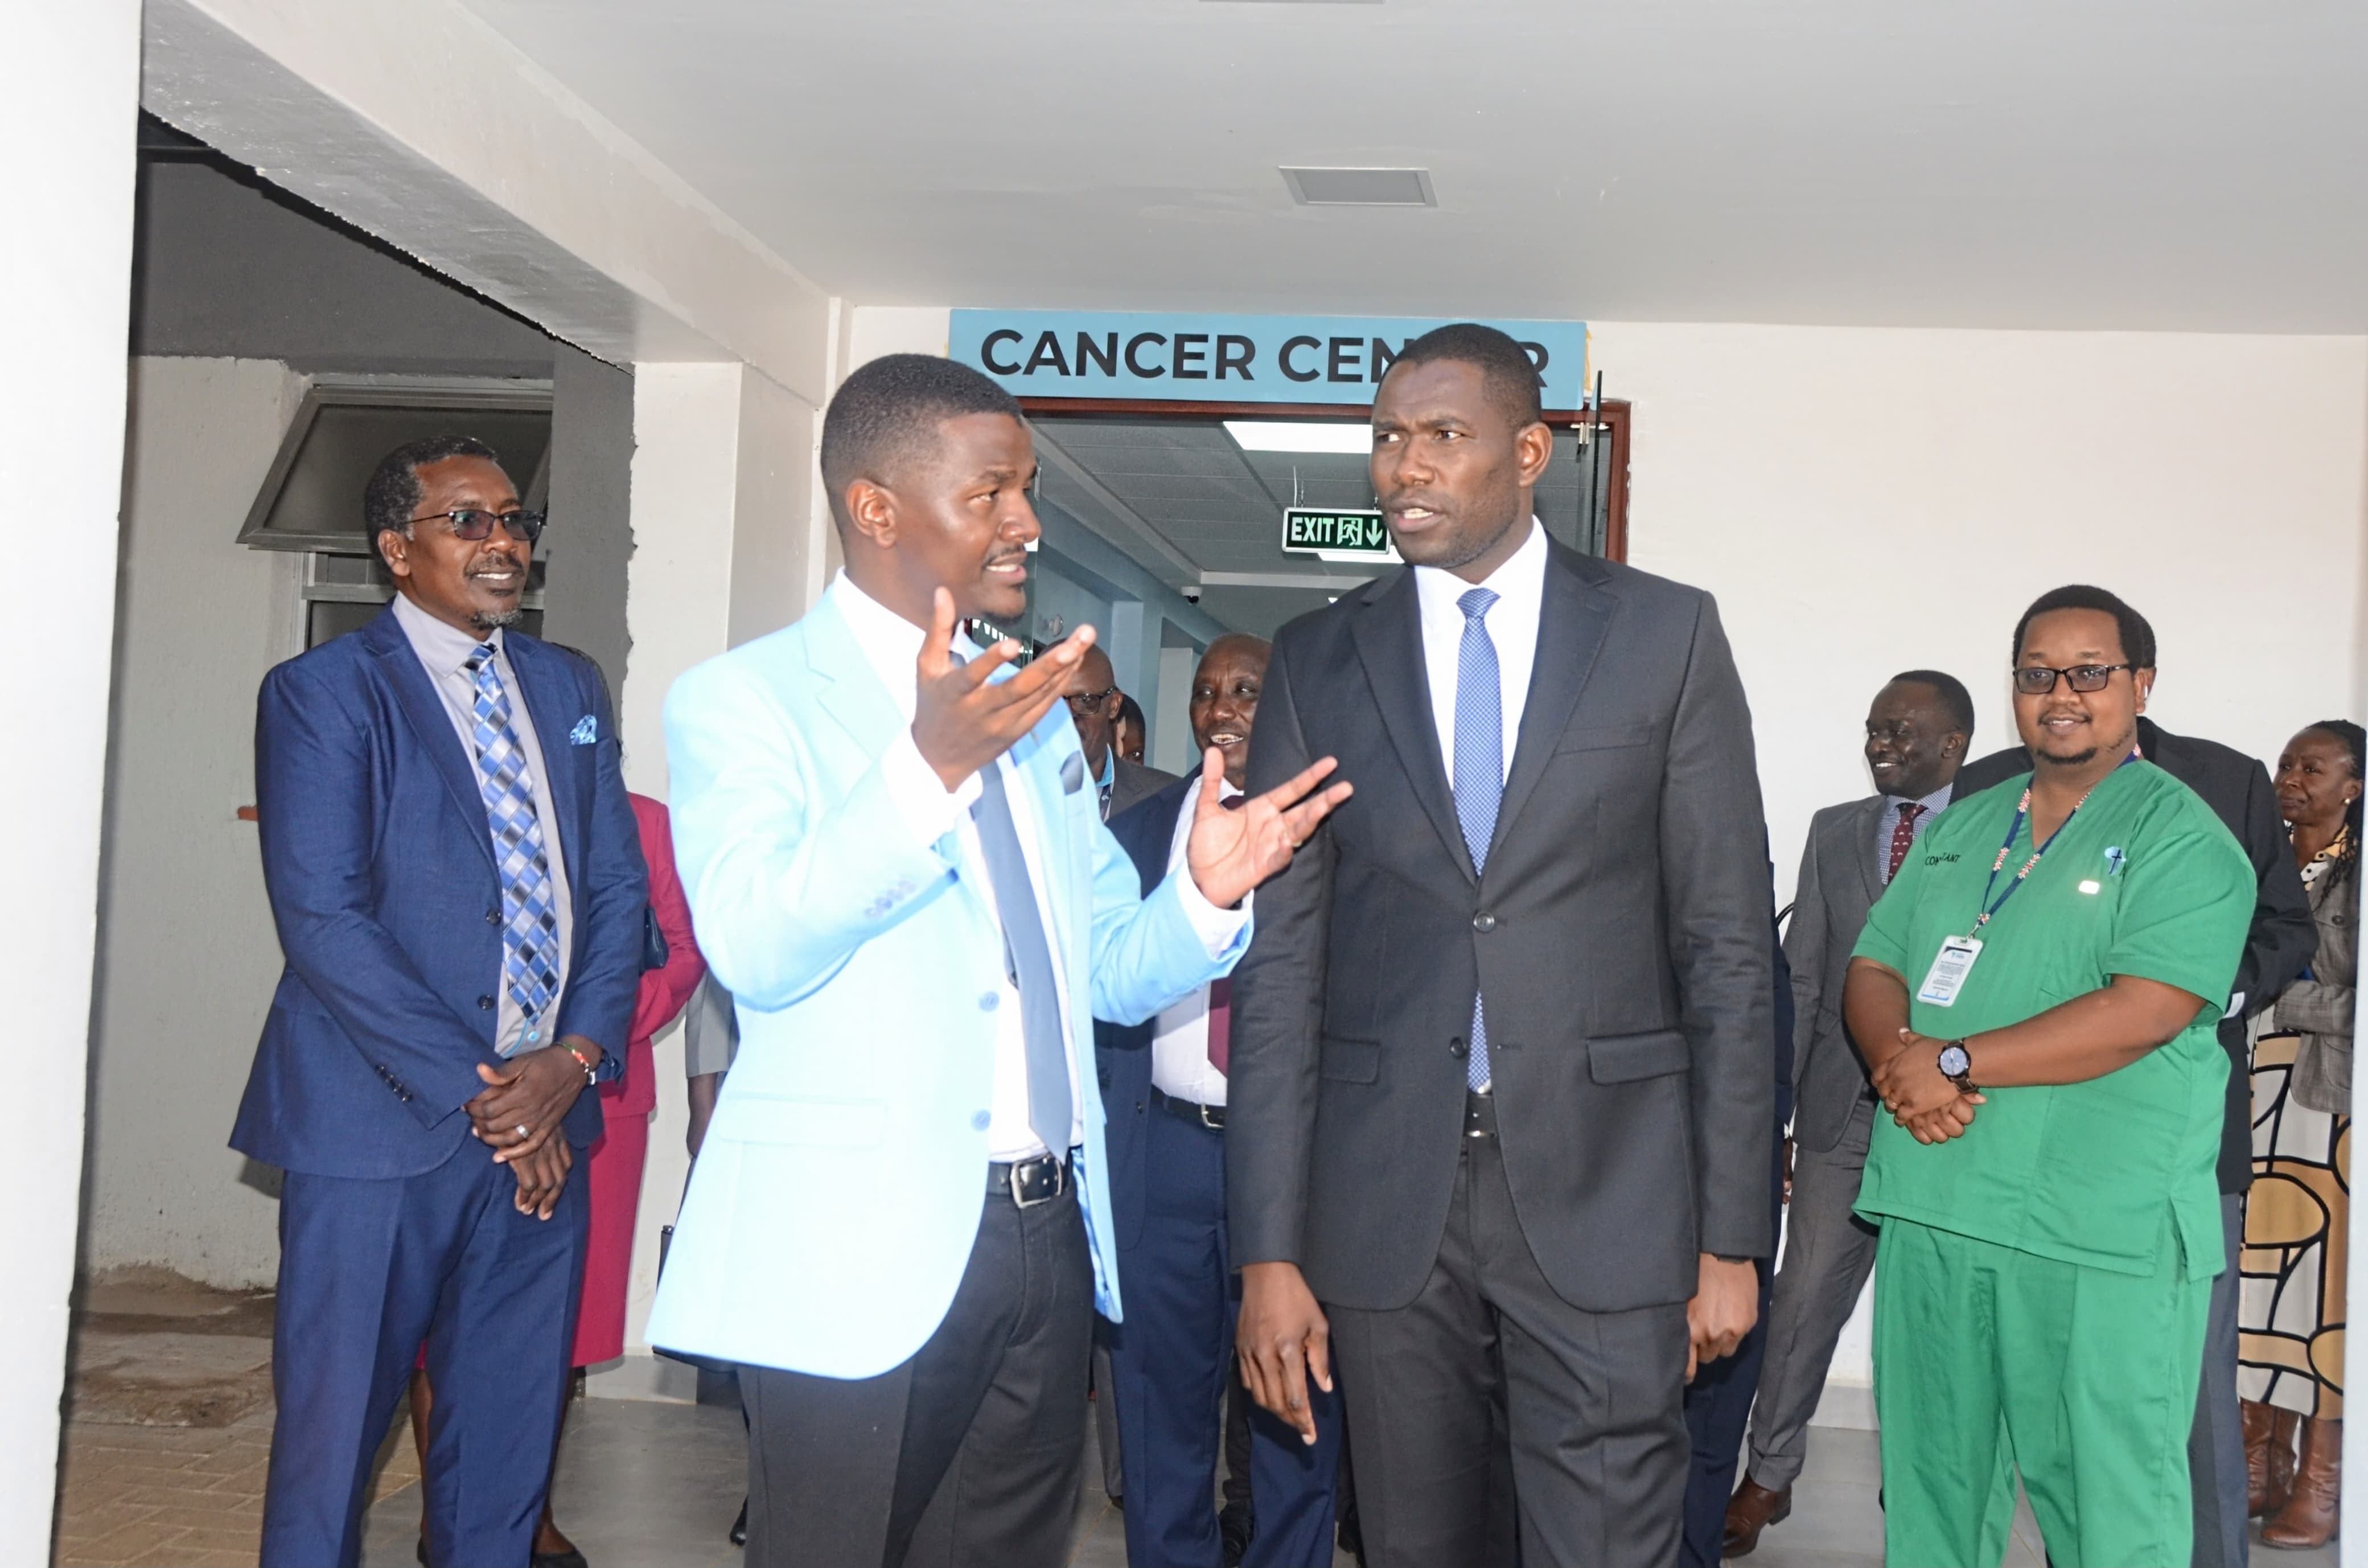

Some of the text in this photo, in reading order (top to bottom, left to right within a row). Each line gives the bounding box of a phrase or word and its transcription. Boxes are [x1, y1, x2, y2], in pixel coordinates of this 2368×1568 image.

[981, 329, 1549, 388] CANCER CENR
[1291, 517, 1334, 542] EXIT
